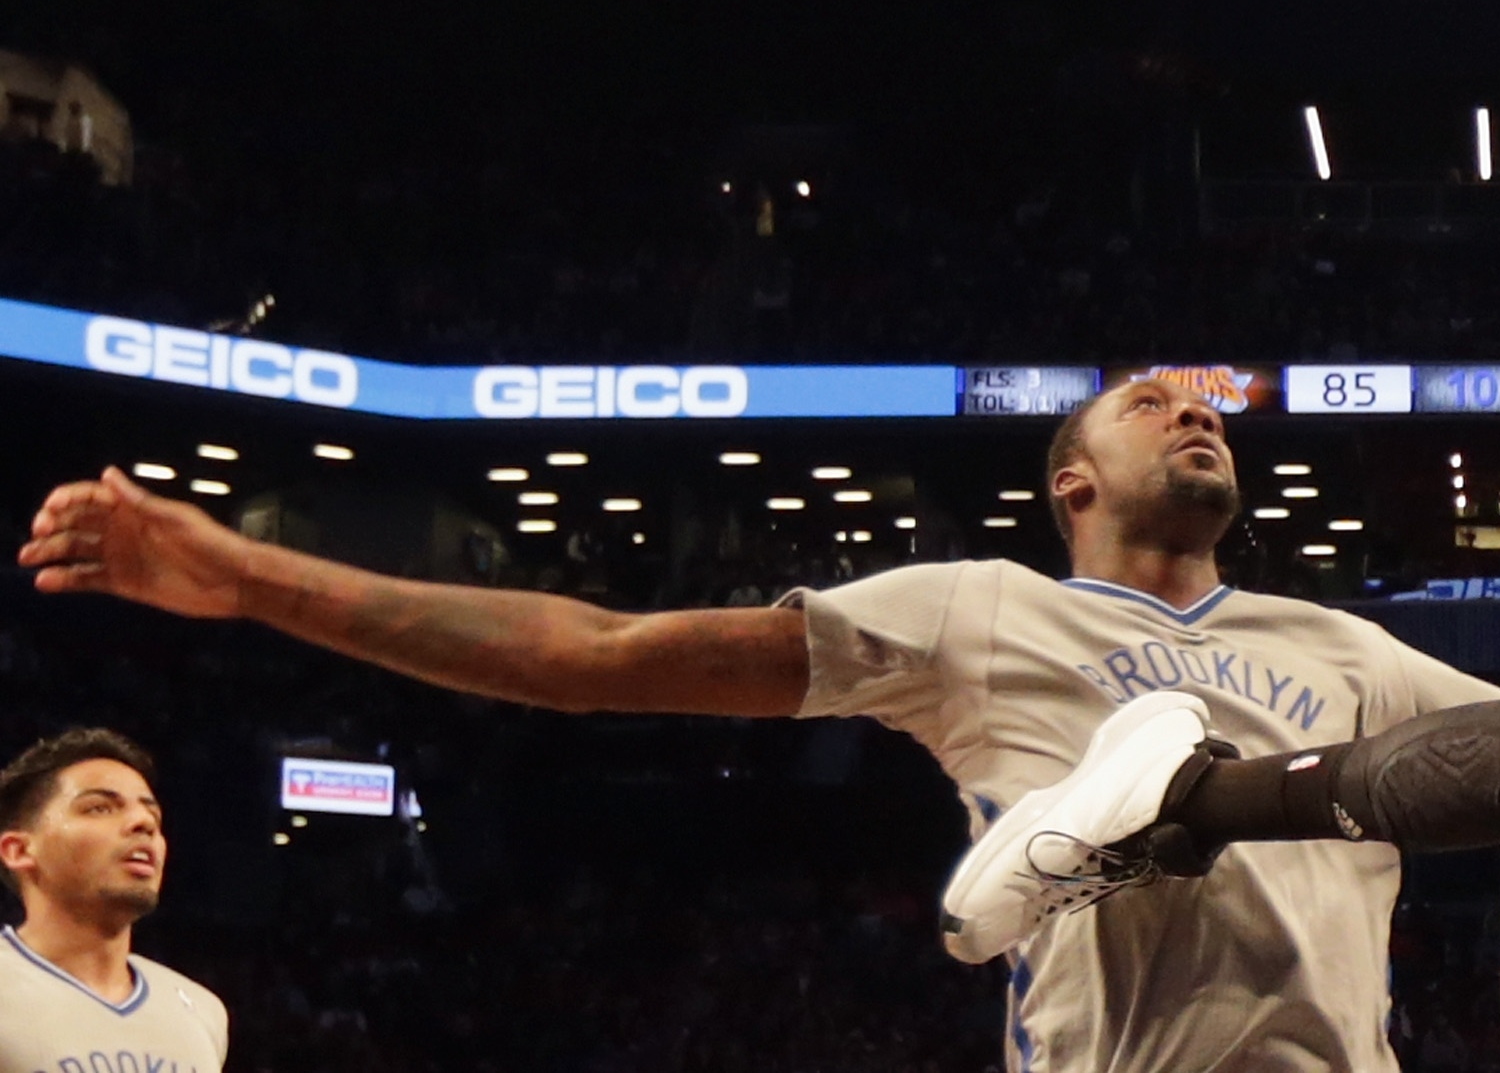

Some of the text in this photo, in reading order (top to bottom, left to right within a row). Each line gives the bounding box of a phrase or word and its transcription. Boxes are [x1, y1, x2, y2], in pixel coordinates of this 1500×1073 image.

[84, 315, 359, 409] GEICO
[472, 365, 748, 419] GEICO
[1321, 372, 1378, 407] 85
[1077, 641, 1325, 731] BROOKLYN
